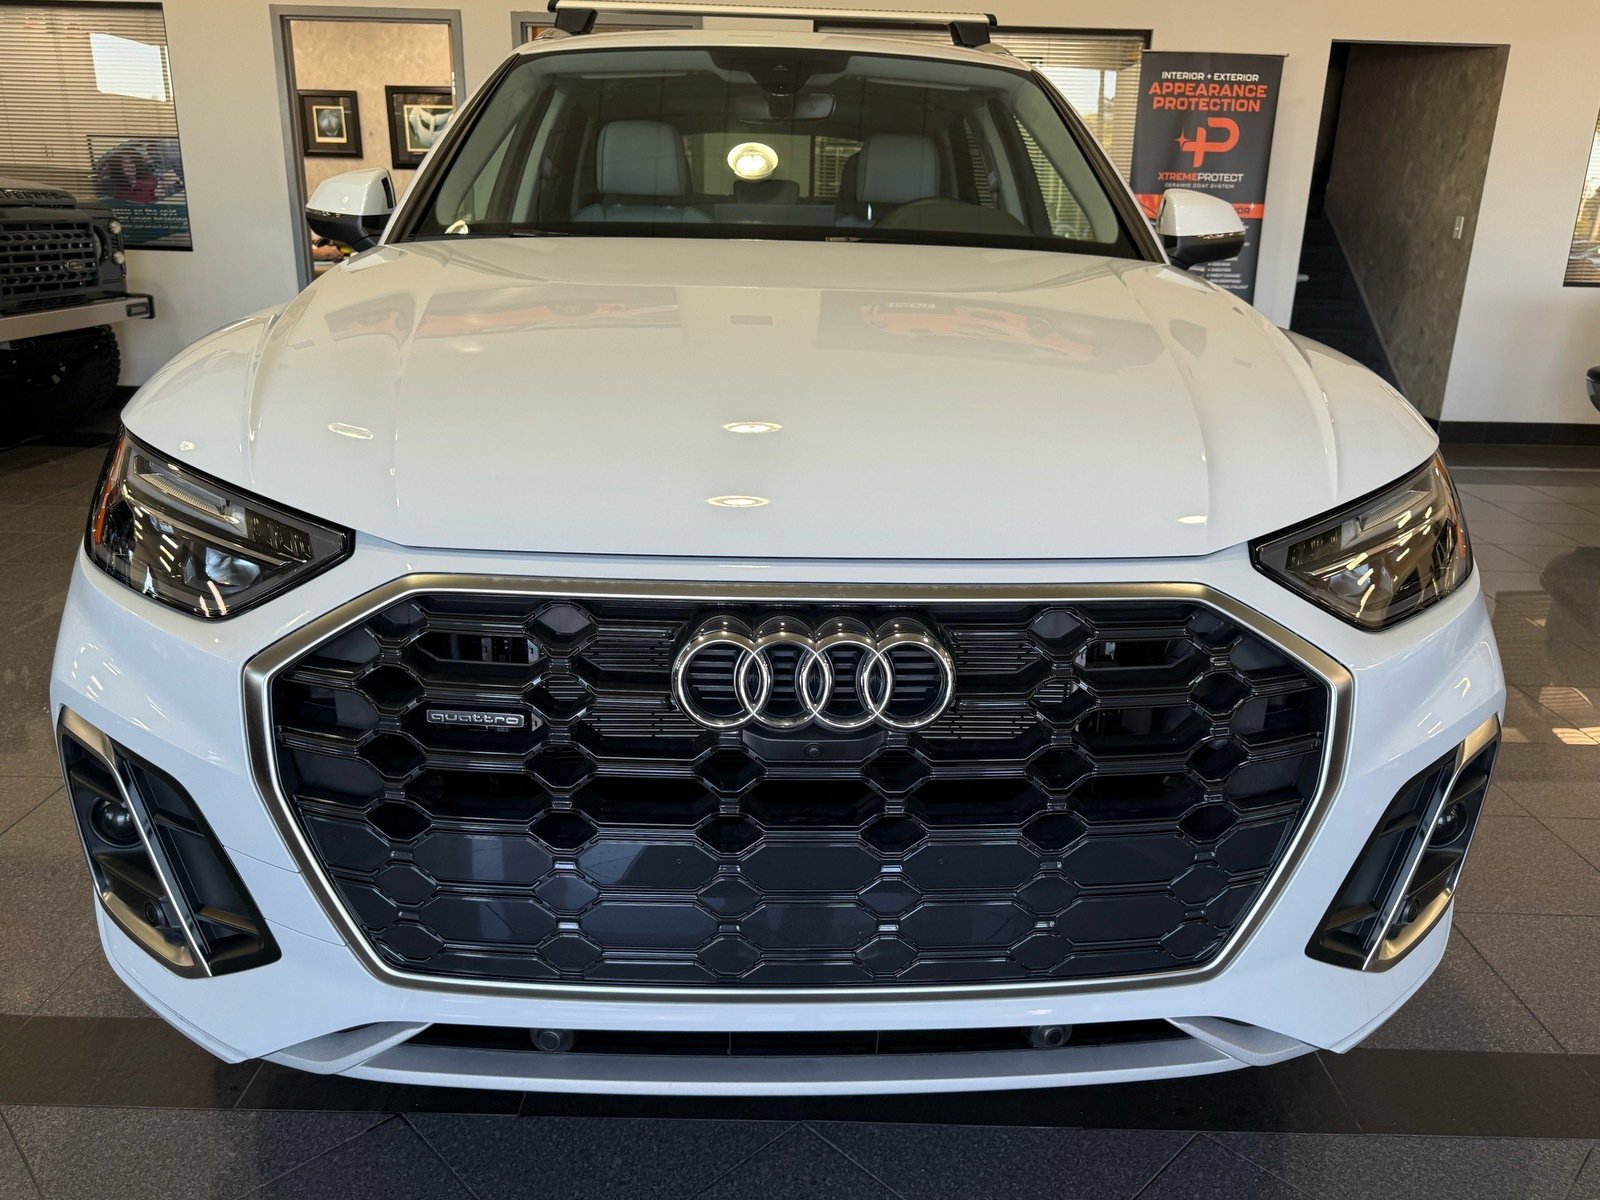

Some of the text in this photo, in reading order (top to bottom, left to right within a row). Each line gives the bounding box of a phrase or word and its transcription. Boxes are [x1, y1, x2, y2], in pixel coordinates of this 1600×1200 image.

[1161, 71, 1204, 80] INTERIOR
[1213, 73, 1259, 82] EXTERIOR
[1148, 82, 1268, 98] APPEARANCE
[1152, 97, 1260, 112] PROTECTION
[431, 713, 519, 725] quattro
